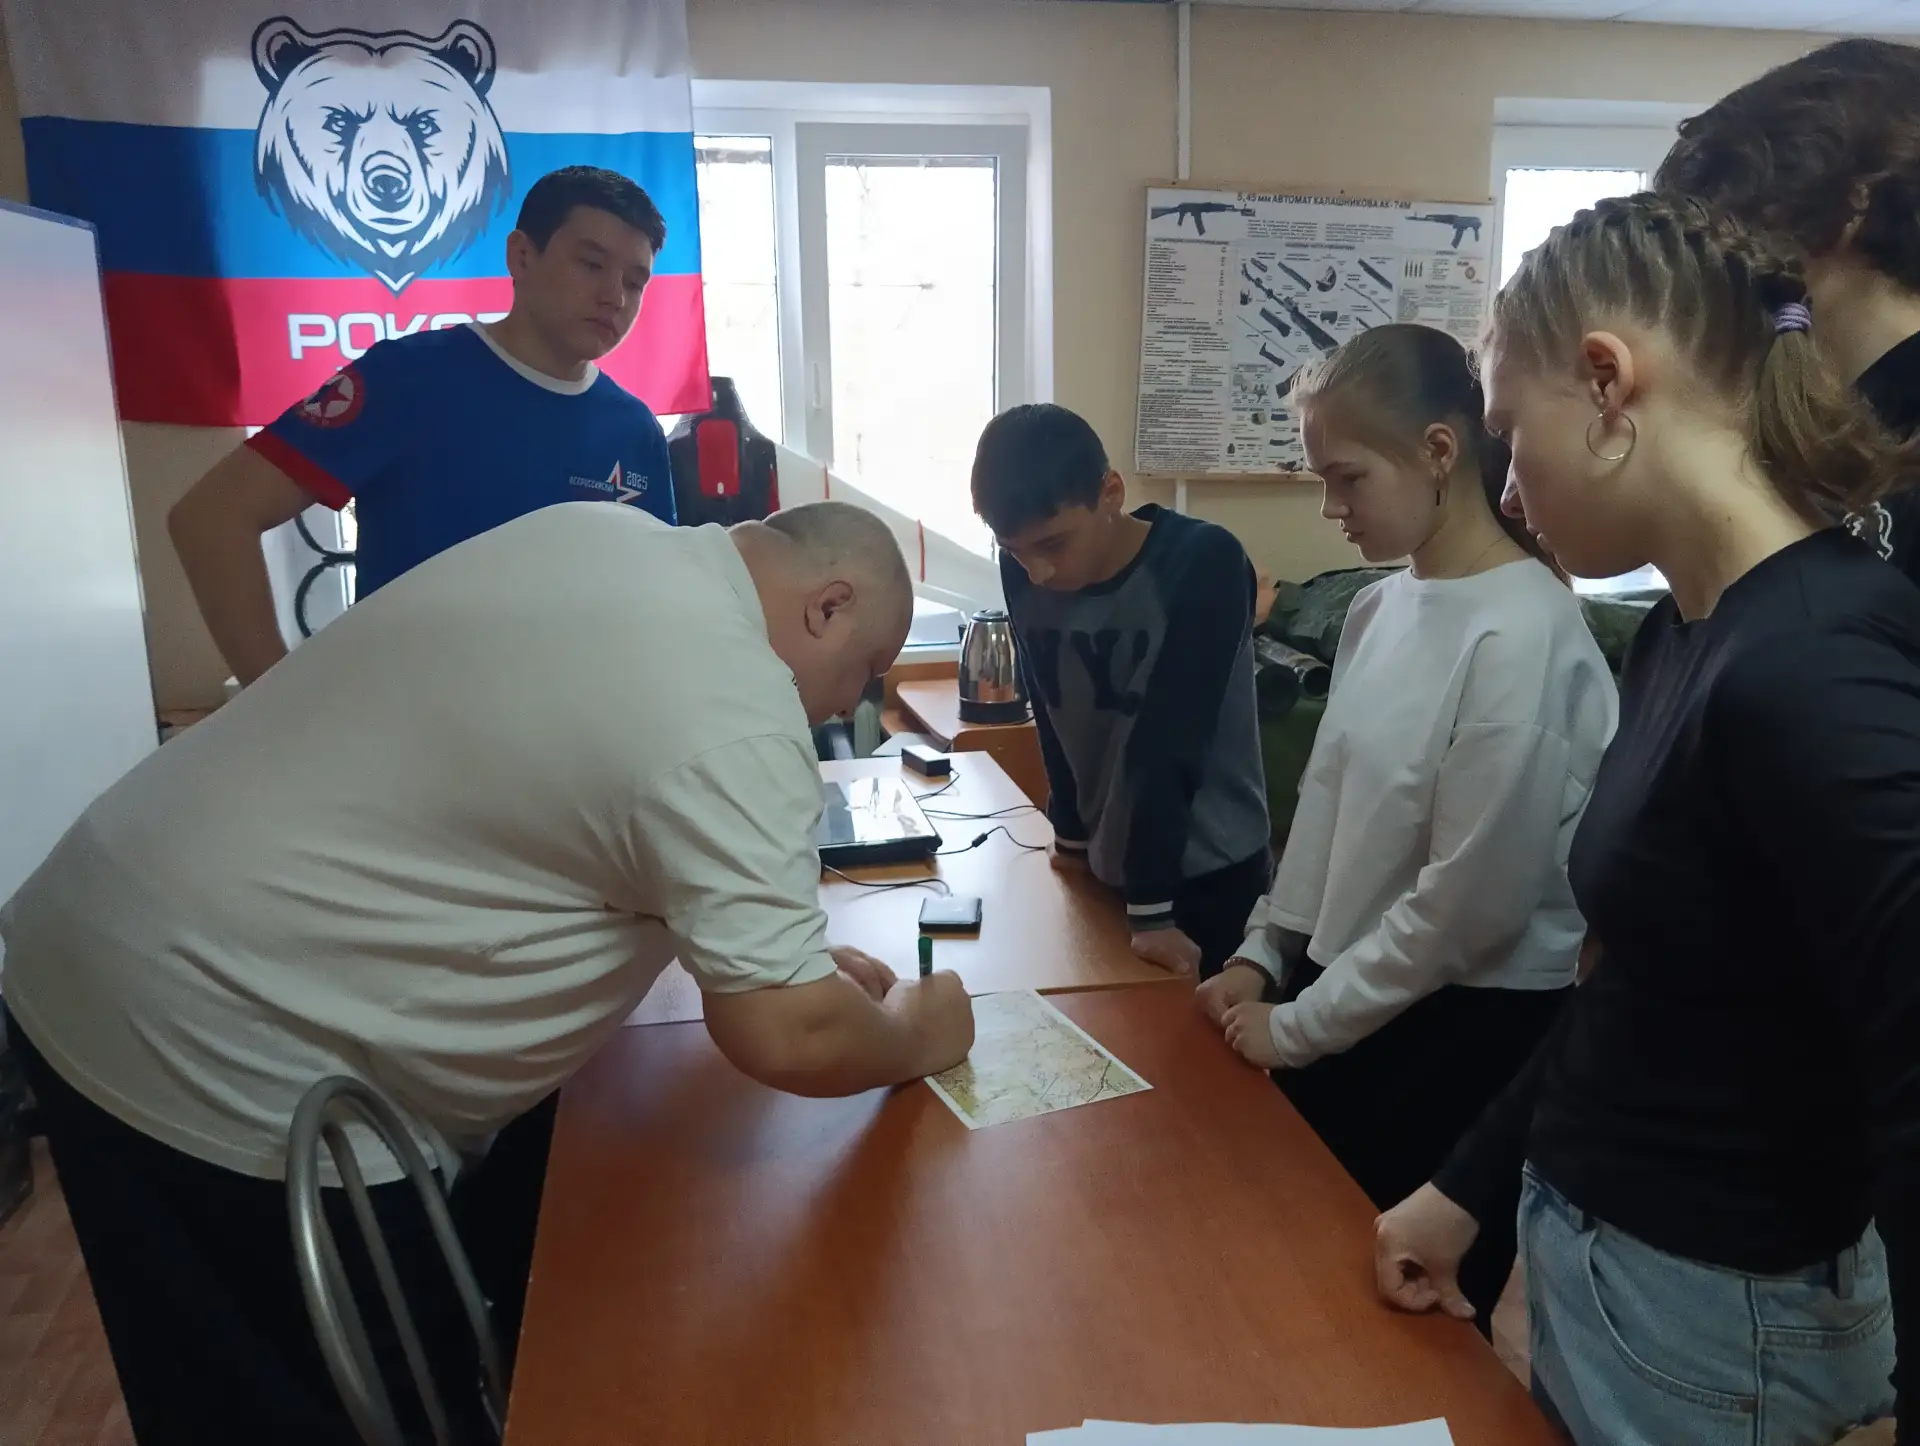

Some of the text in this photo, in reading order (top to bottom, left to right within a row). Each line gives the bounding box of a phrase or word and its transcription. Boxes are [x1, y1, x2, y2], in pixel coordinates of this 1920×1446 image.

[1272, 195, 1313, 206] АВТОМАТ
[1313, 196, 1379, 209] КАЛАШНИКОВА
[287, 312, 511, 360] РОК
[626, 471, 648, 490] 2025
